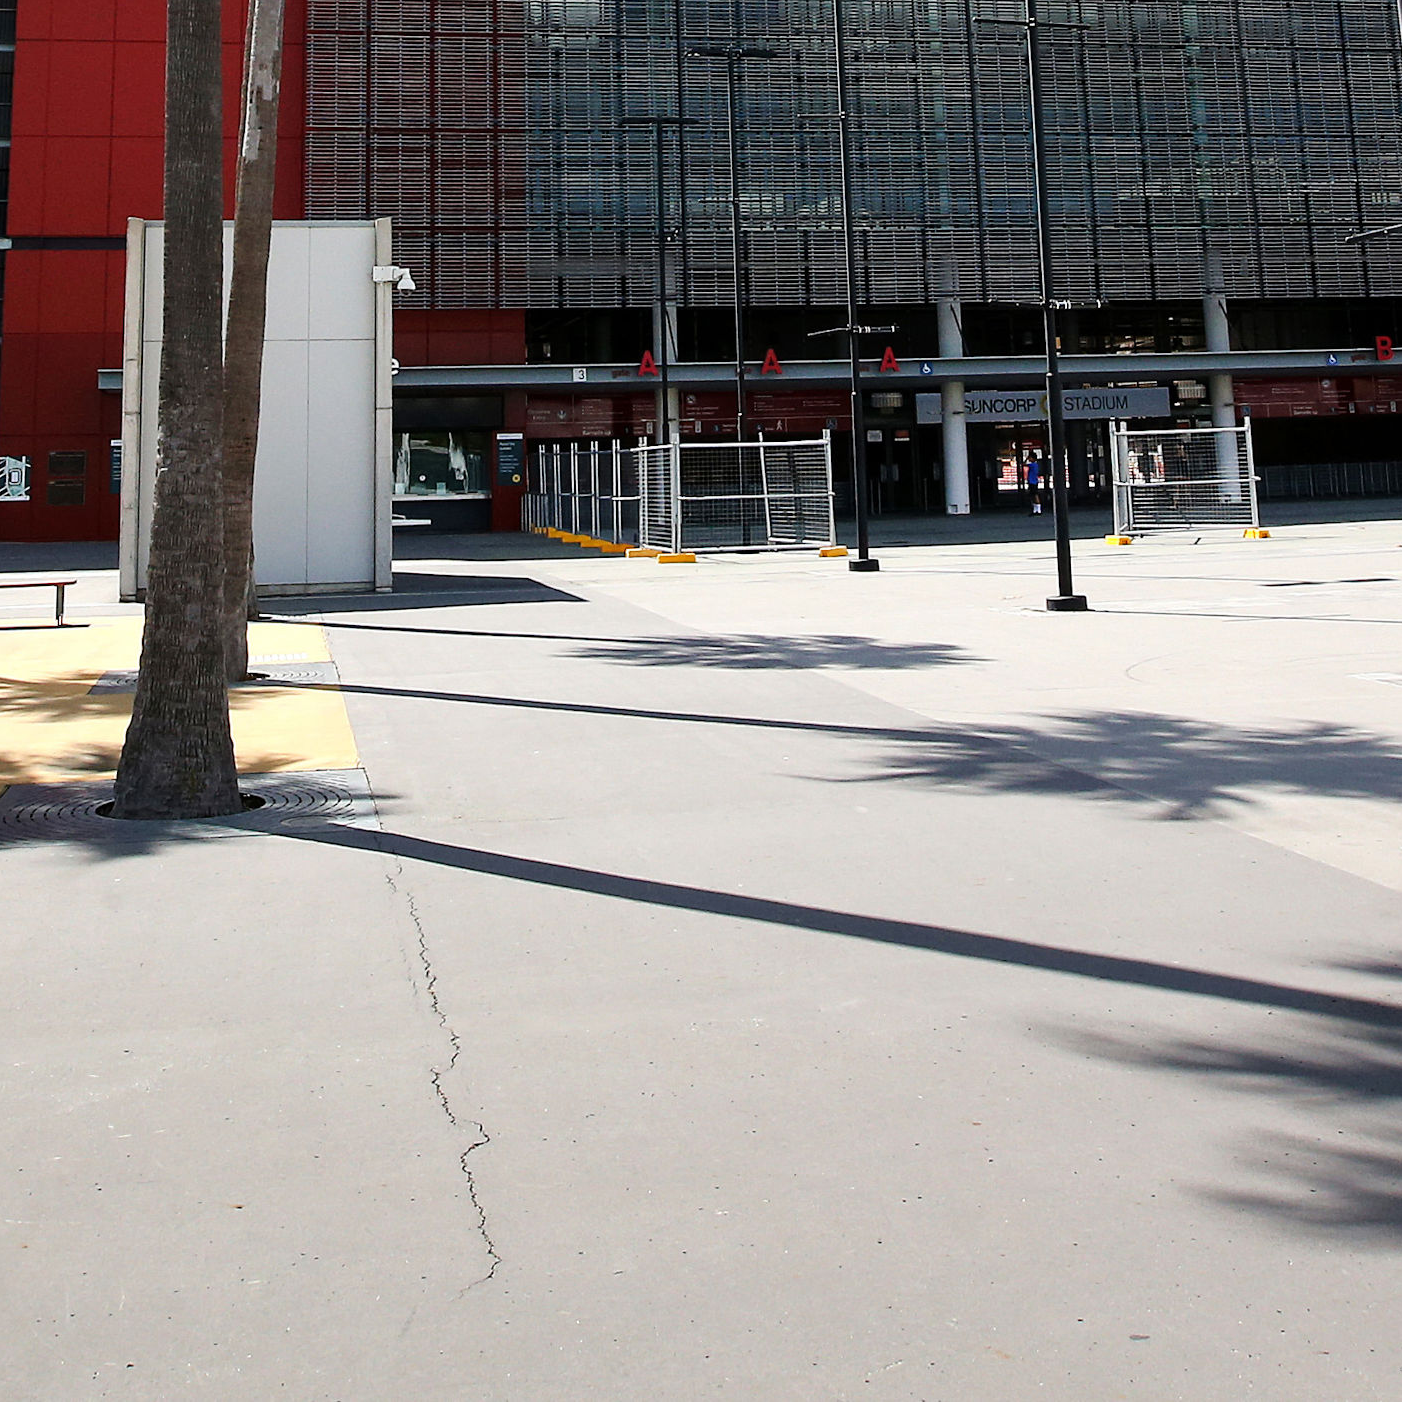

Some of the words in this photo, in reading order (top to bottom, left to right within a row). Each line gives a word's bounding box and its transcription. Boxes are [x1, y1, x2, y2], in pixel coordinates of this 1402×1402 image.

[761, 348, 782, 374] A
[879, 346, 900, 372] A
[1376, 335, 1395, 361] B
[578, 369, 585, 380] 3
[637, 350, 659, 376] A
[1064, 395, 1128, 411] STADIUM
